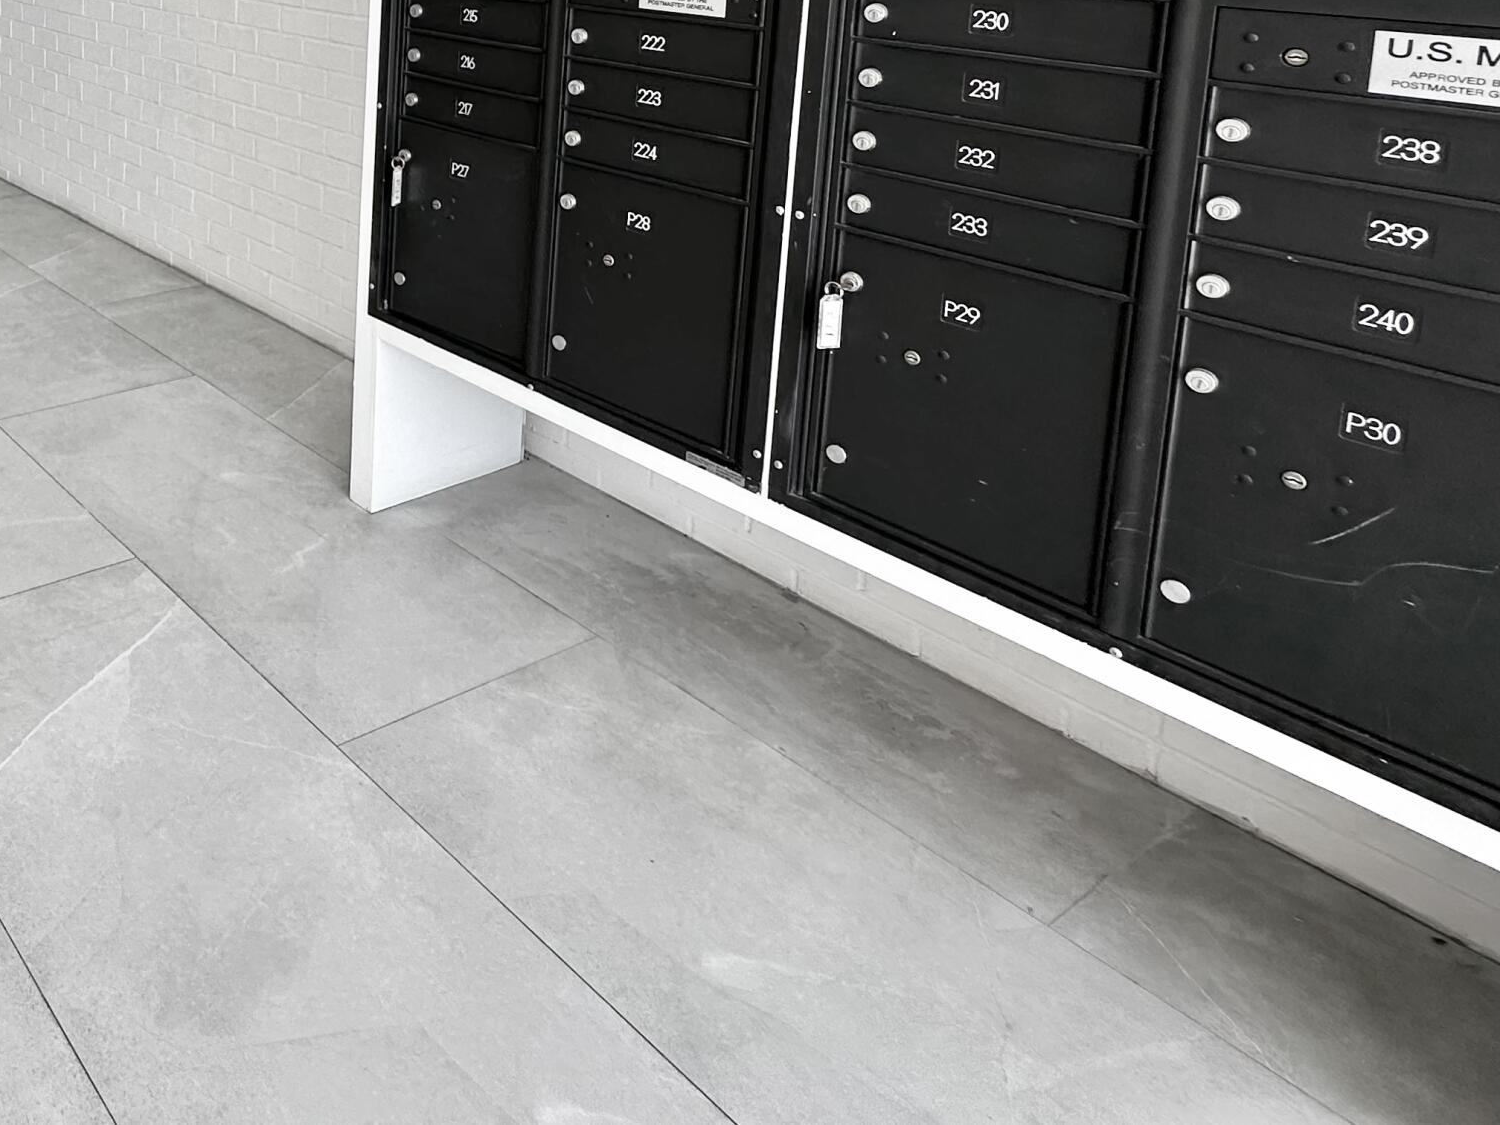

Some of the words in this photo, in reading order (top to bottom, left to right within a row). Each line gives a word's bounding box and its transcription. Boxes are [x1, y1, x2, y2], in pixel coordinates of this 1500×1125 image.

[462, 8, 479, 23] 215
[972, 9, 1010, 32] 230
[640, 34, 666, 52] 222
[1388, 37, 1463, 64] U.S.
[460, 54, 476, 70] 216
[968, 78, 1001, 101] 231
[1390, 79, 1484, 96] POSTMASTER
[1409, 71, 1486, 86] APPROVED
[457, 101, 473, 116] 217
[636, 88, 662, 107] 223
[633, 141, 658, 161] 224
[957, 145, 996, 170] 232
[1380, 135, 1442, 165] 238
[451, 162, 470, 178] P27
[626, 211, 651, 232] P28
[951, 212, 988, 237] 233
[1368, 219, 1430, 250] 239
[943, 299, 981, 325] P29
[1357, 303, 1415, 335] 240
[1345, 411, 1402, 446] P30
